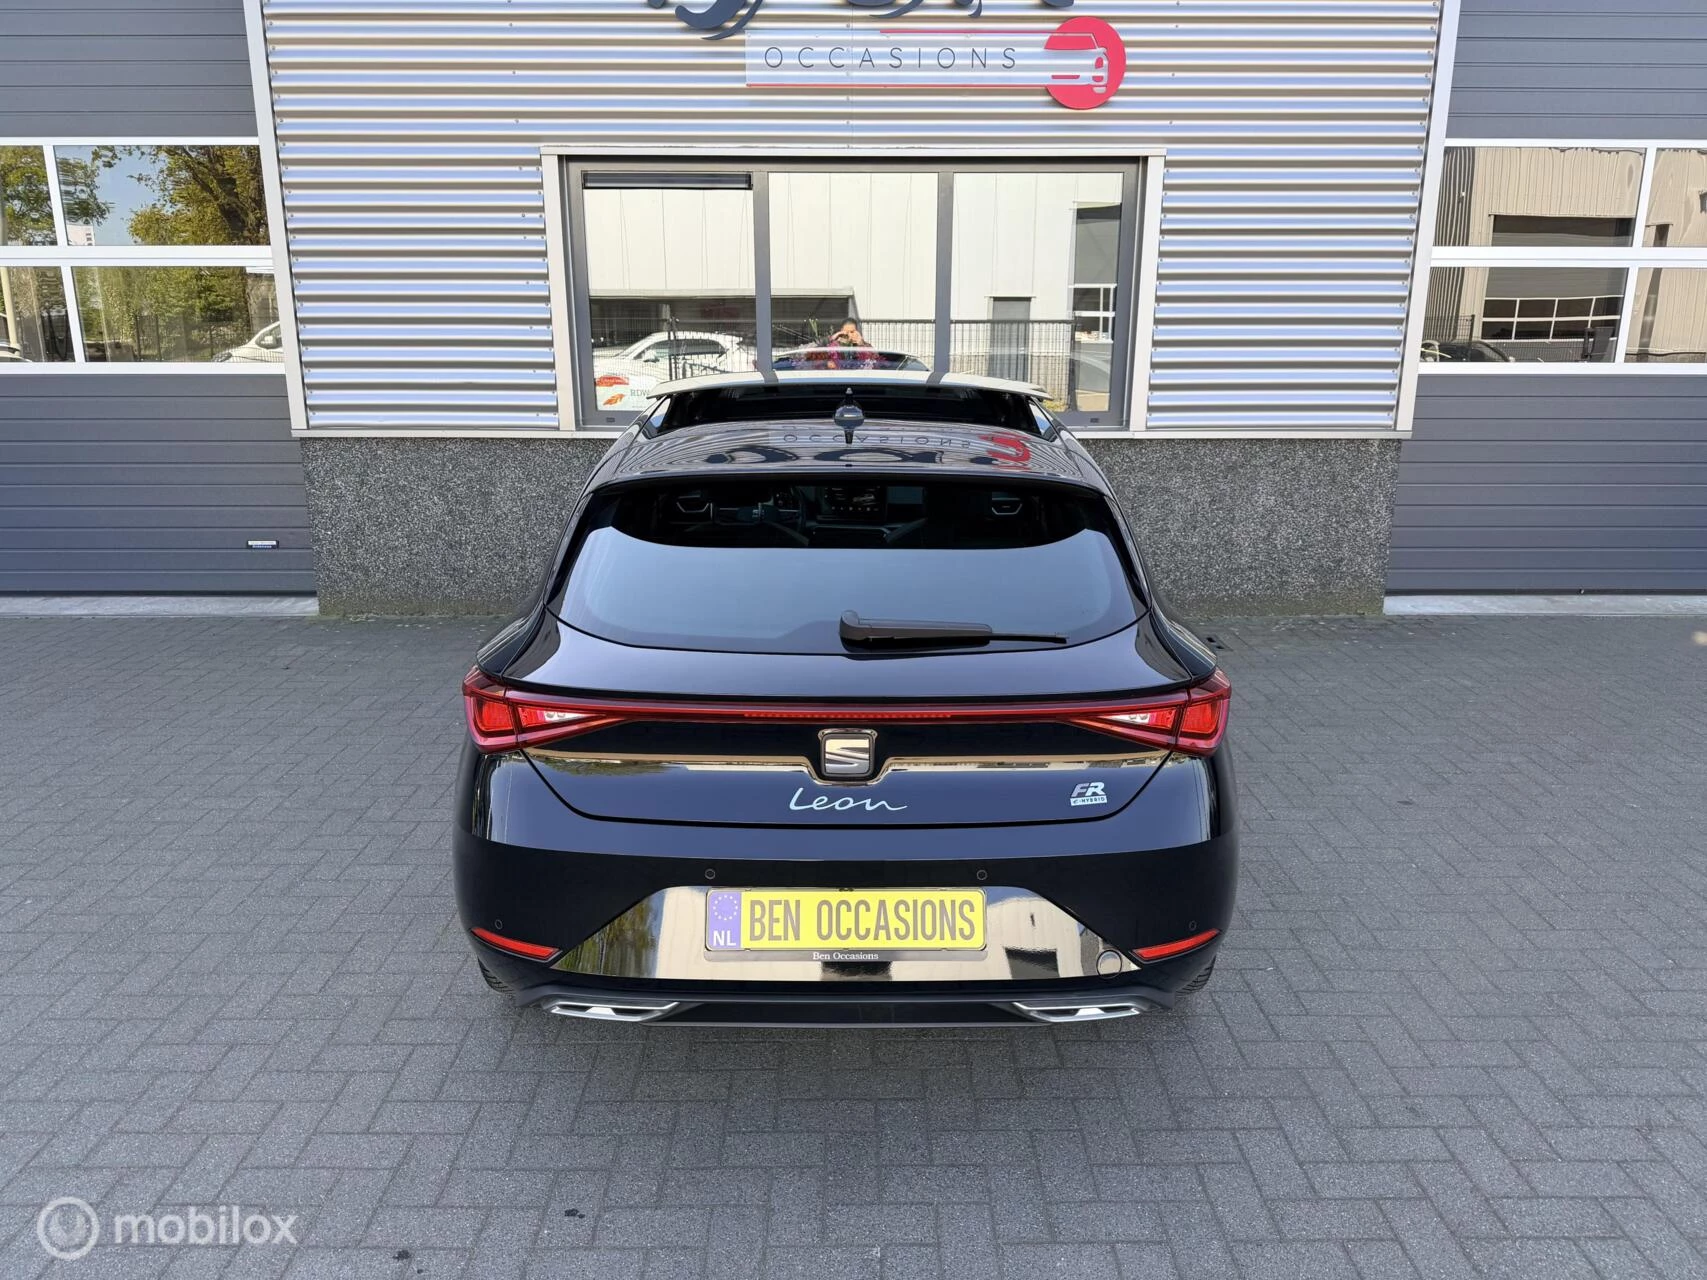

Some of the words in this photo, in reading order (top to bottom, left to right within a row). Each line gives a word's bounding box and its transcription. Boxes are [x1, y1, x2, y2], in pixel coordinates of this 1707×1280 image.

[764, 46, 1016, 69] OCCASIONS
[789, 787, 908, 811] Leon
[1071, 781, 1106, 797] FR
[749, 899, 801, 941] BEN
[816, 899, 976, 941] OCCASIONS
[712, 930, 737, 947] NL
[812, 951, 831, 960] Ben
[832, 951, 879, 960] Occasions
